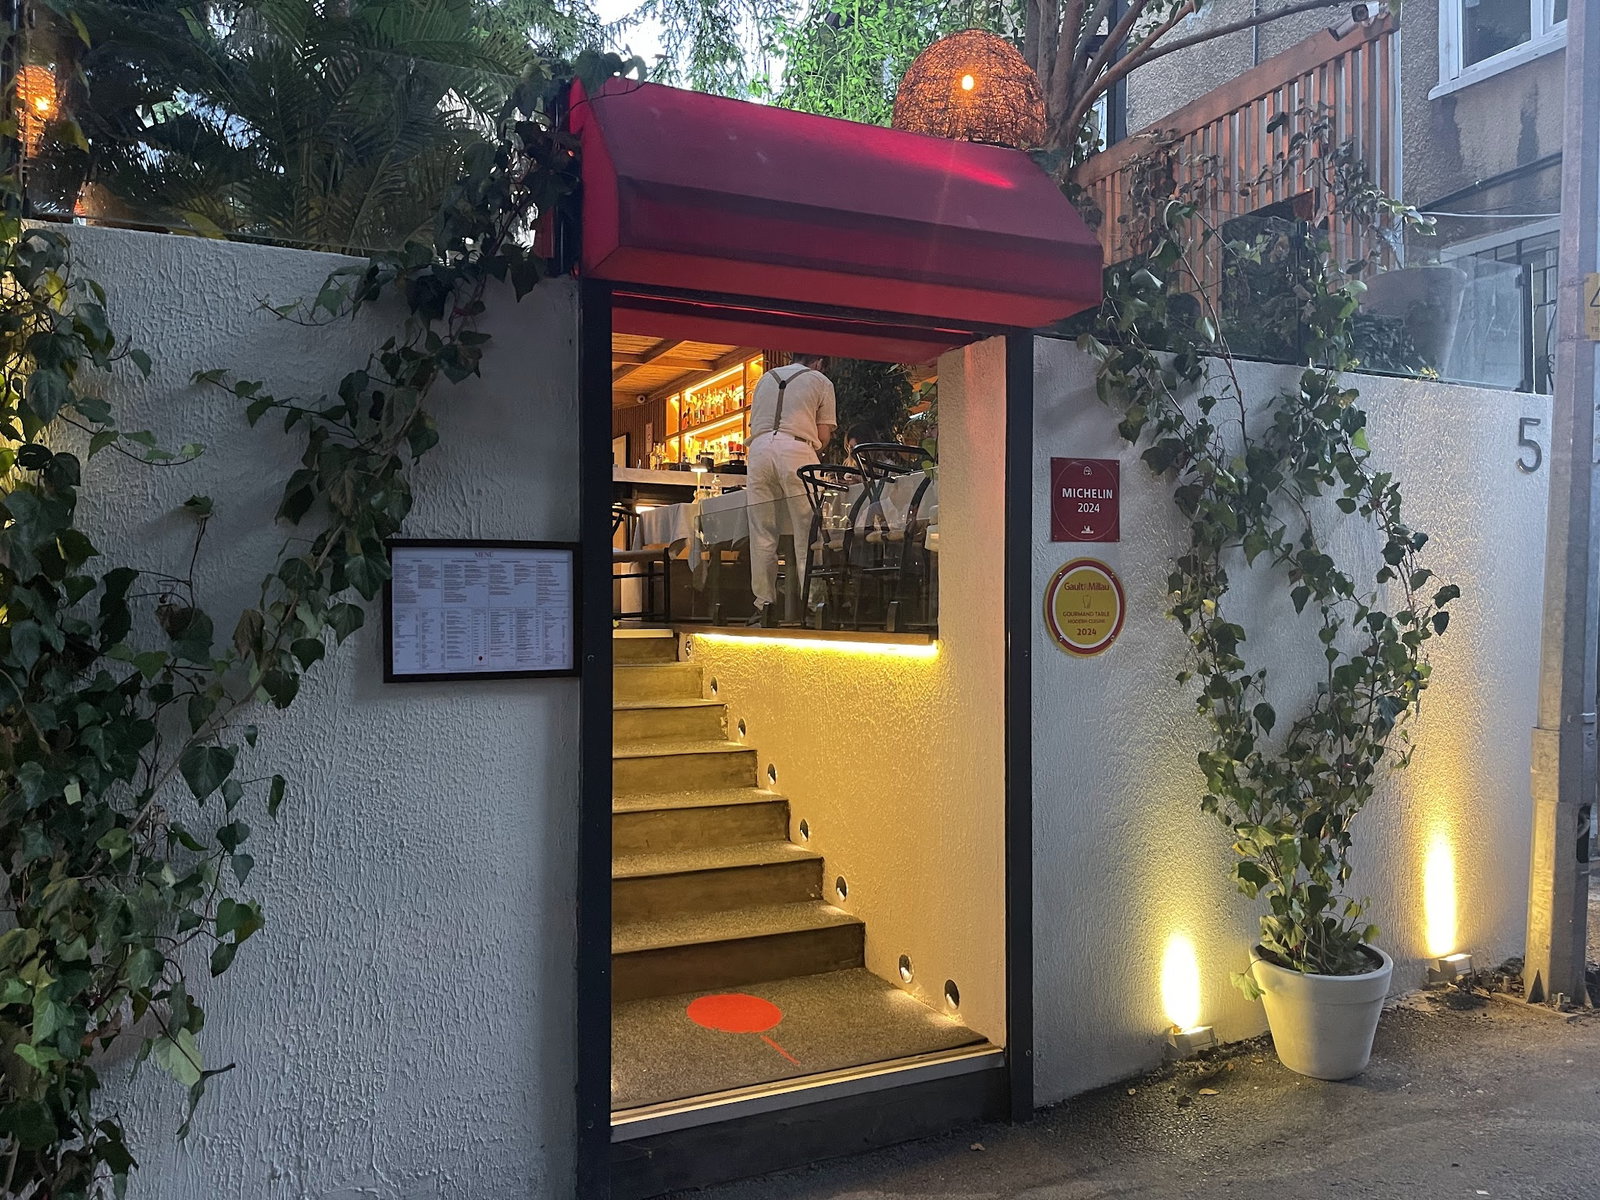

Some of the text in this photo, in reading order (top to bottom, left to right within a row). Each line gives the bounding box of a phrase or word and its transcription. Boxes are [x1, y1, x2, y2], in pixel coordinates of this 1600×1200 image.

[1516, 417, 1543, 474] 5
[1062, 487, 1113, 499] MICHELIN
[1077, 502, 1100, 513] 2024
[1076, 628, 1097, 636] 2024
